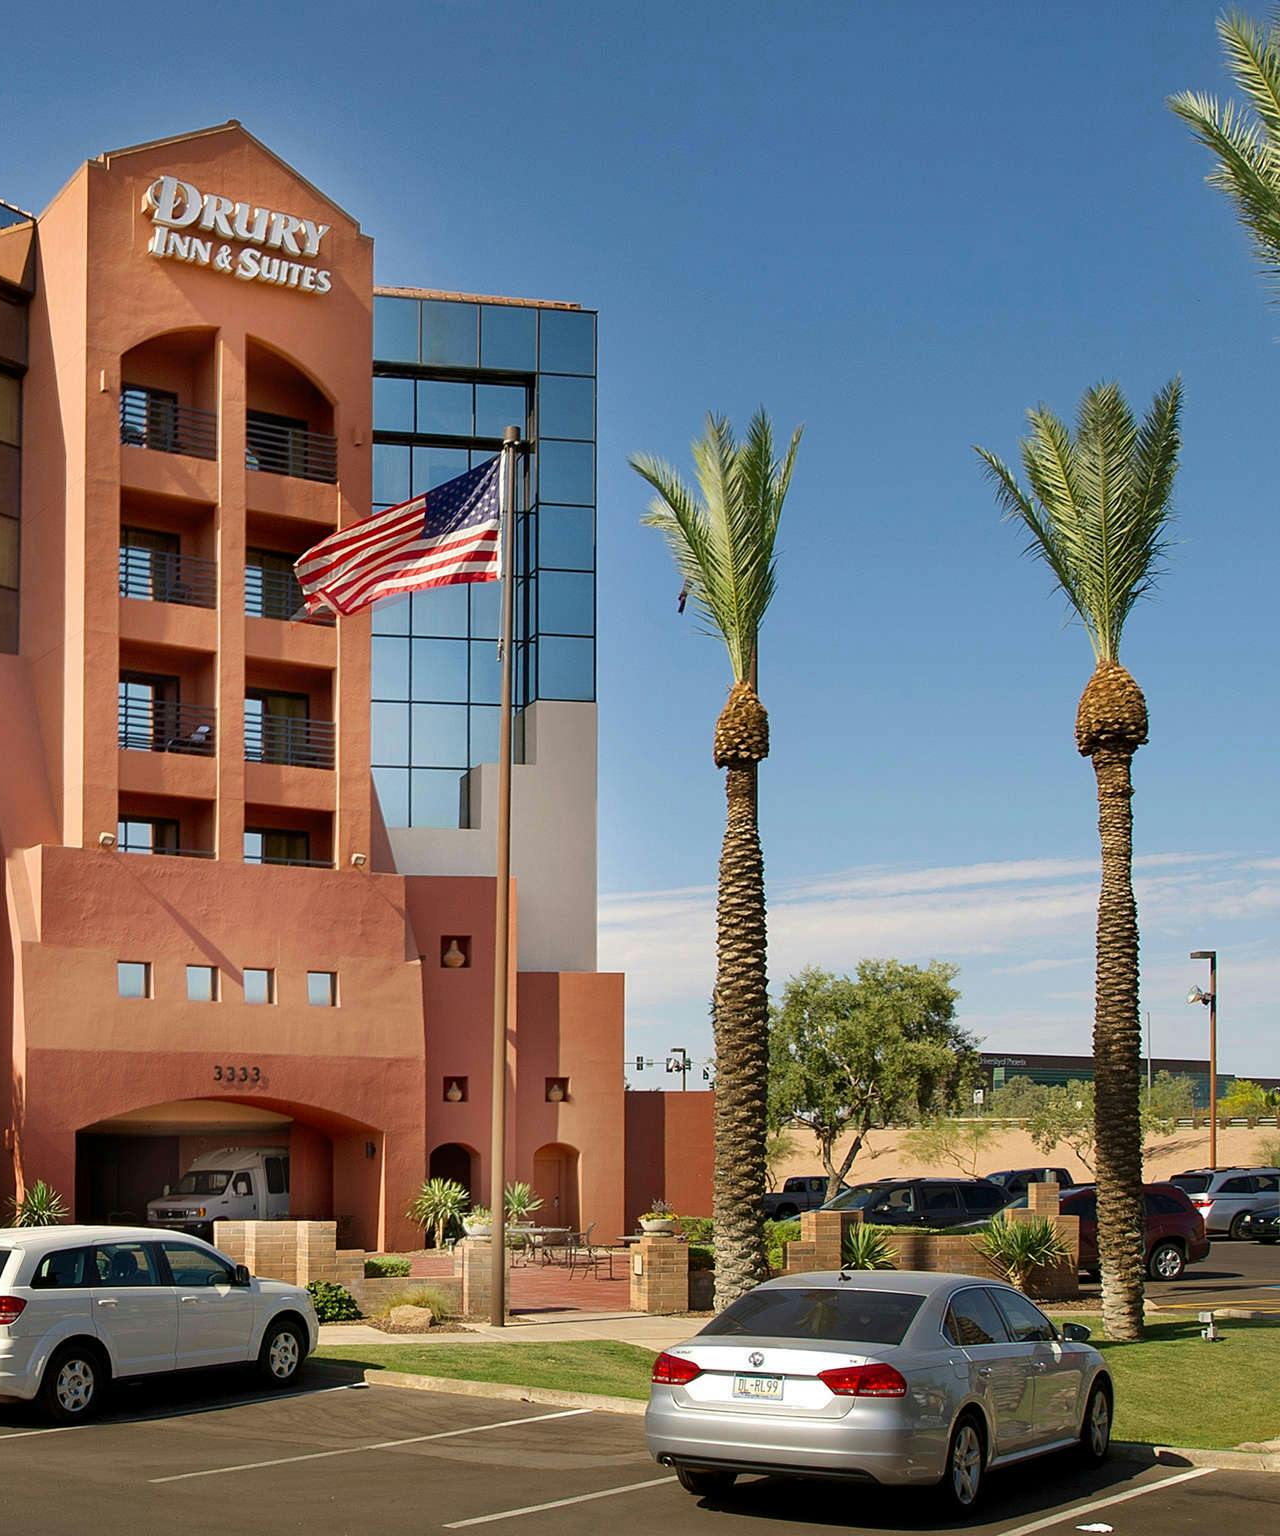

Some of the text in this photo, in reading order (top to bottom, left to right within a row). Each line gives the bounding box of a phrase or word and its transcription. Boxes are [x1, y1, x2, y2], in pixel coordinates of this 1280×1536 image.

[141, 175, 331, 257] DRURY
[148, 224, 332, 294] INN & SUITES
[213, 1065, 260, 1082] 3333
